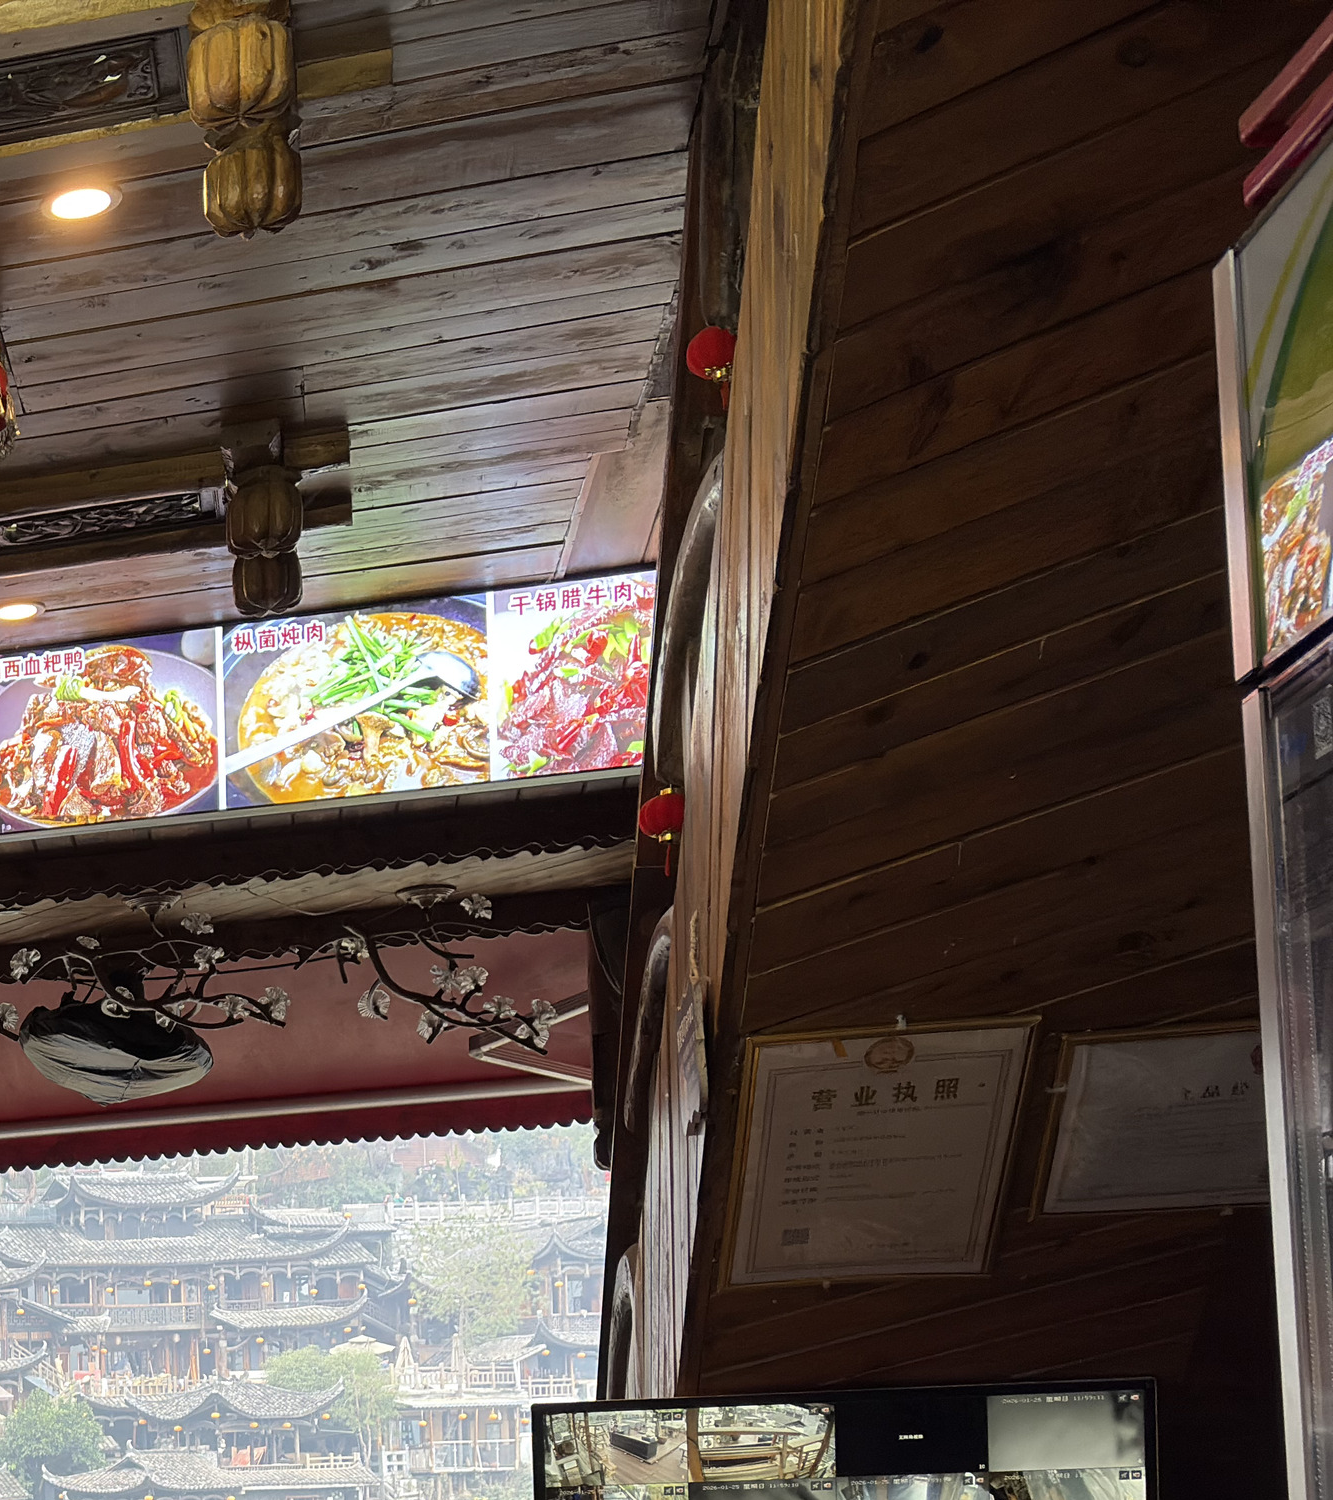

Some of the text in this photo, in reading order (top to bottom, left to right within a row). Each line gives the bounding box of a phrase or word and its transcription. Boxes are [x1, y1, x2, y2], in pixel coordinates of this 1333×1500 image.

[510, 582, 633, 614] 干锅腊牛肉
[233, 623, 325, 652] 枞菌炖肉
[811, 1078, 960, 1112] 营业执照
